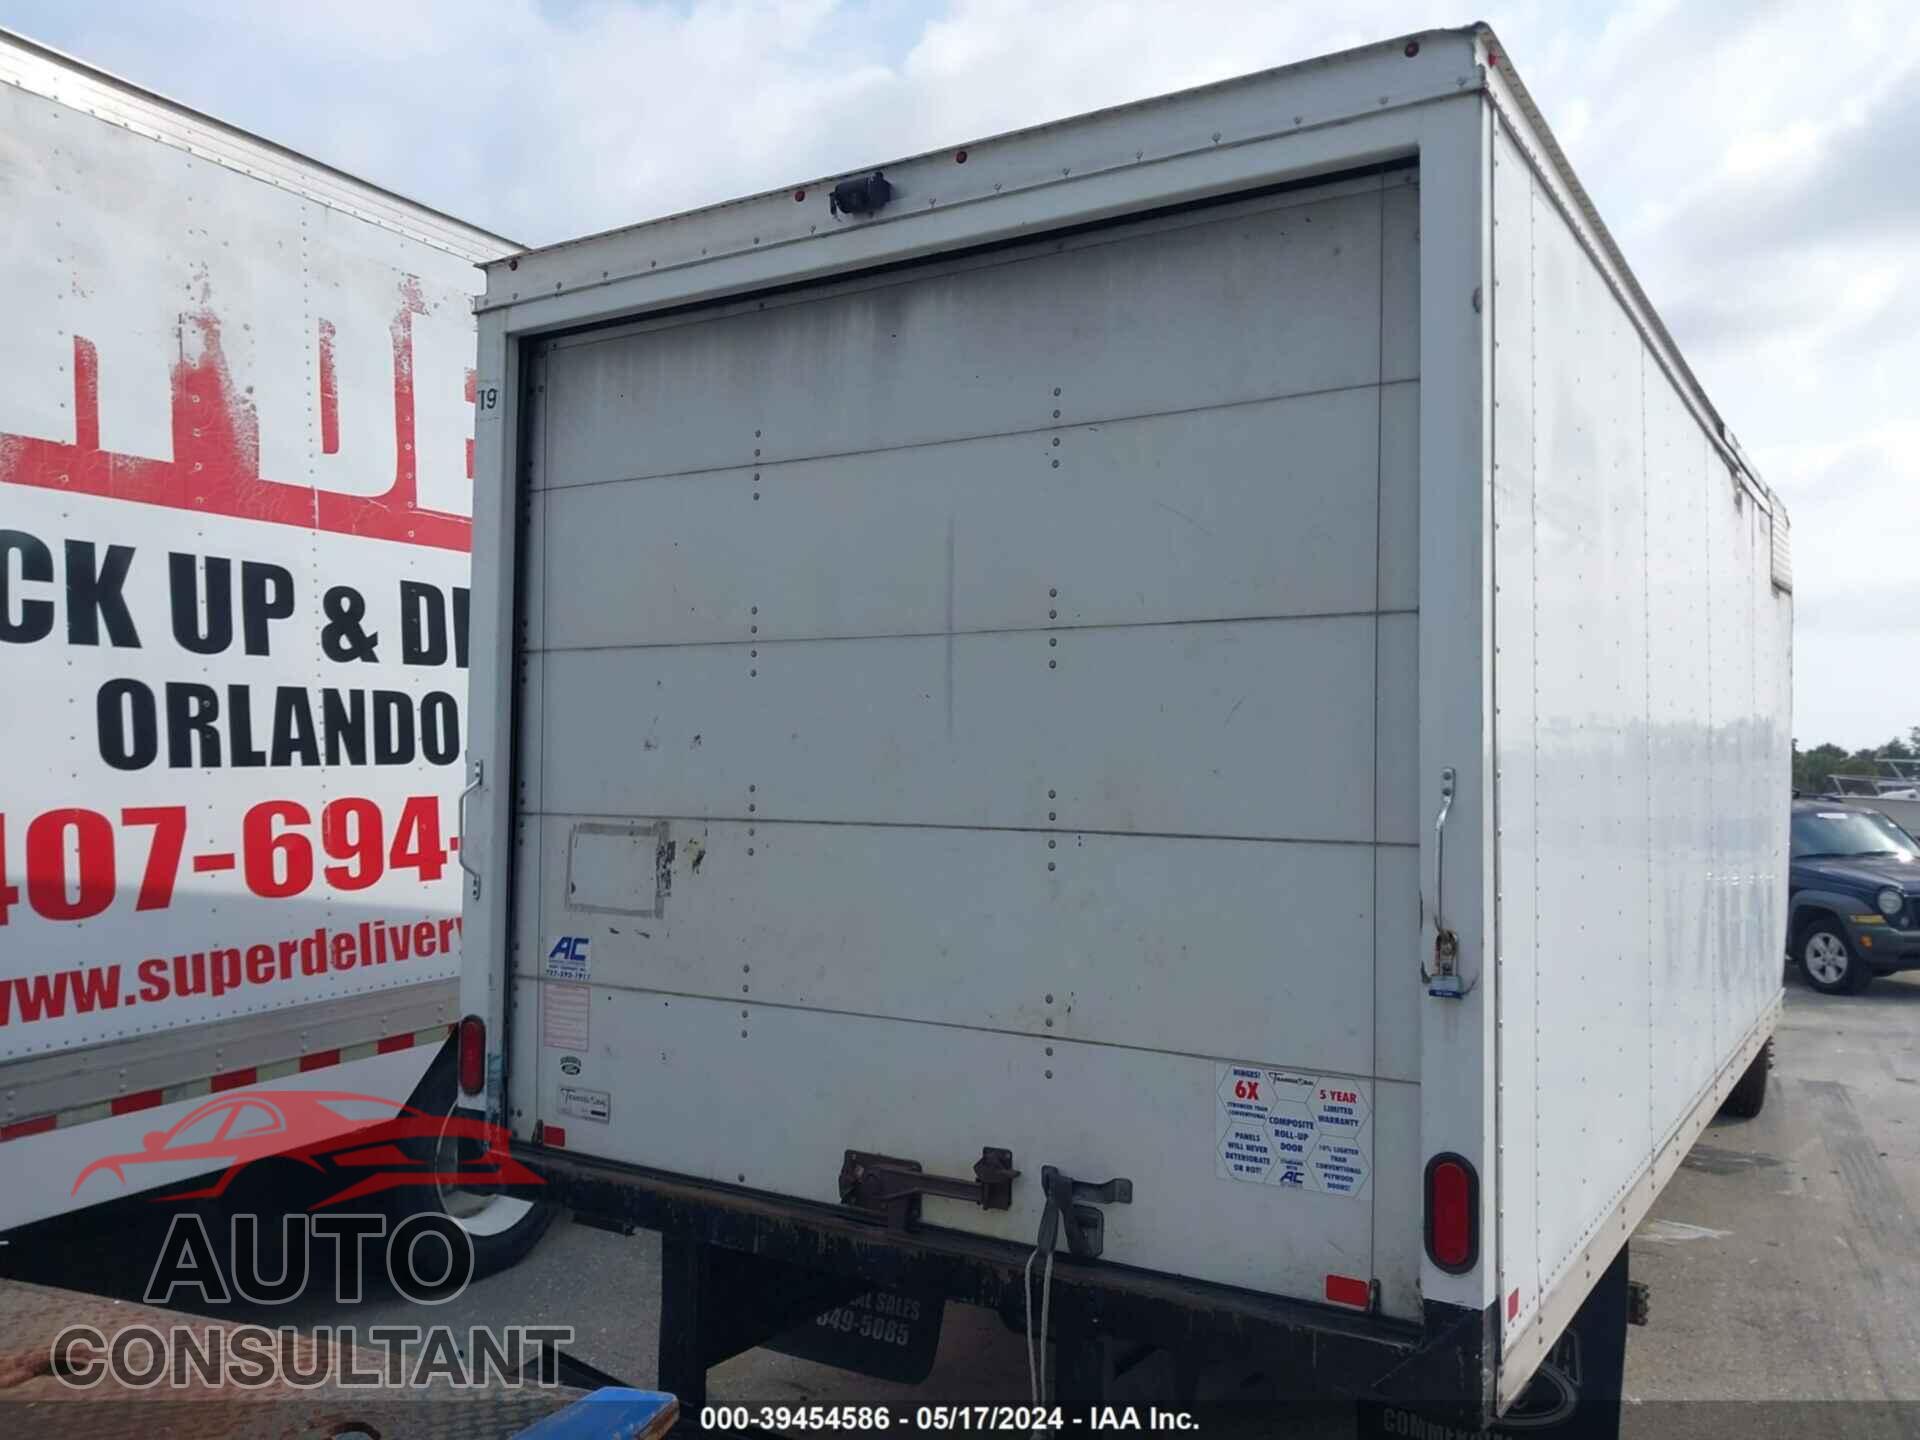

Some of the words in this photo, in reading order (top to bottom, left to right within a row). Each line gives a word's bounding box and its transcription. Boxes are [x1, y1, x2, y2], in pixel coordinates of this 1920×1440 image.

[168, 552, 295, 656] UP
[321, 585, 380, 663] &
[97, 678, 460, 770] ORLANDO
[549, 936, 589, 961] AC
[1235, 1080, 1260, 1101] 6X
[1320, 1089, 1327, 1100] 5
[1330, 1090, 1357, 1104] YEAR
[1269, 1116, 1315, 1130] COMPOSITE
[1318, 1114, 1359, 1127] WARRANTY
[1235, 1131, 1260, 1142] PANELS
[1274, 1129, 1309, 1142] ROLL-UP
[1280, 1142, 1303, 1153] DOOR
